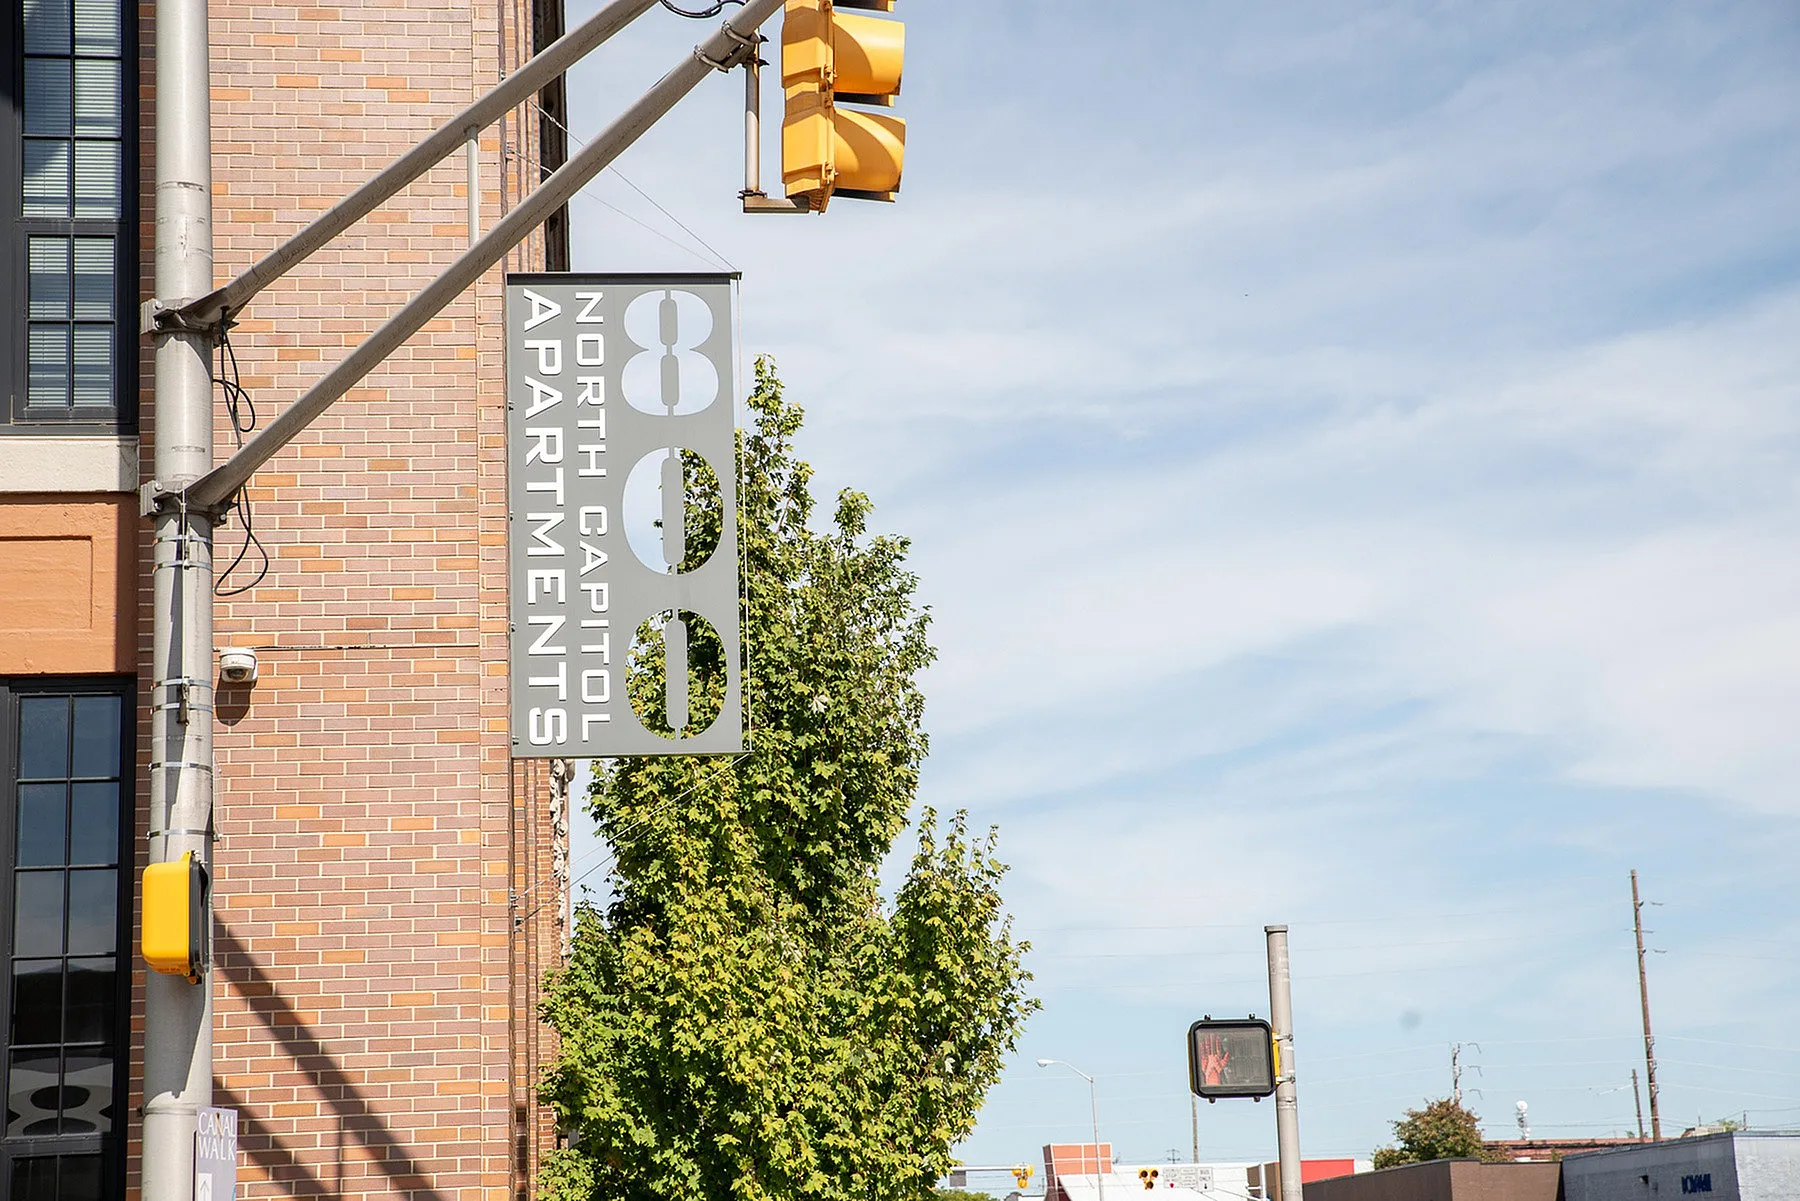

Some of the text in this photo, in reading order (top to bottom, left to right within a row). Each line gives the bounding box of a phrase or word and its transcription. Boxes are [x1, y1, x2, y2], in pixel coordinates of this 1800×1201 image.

[523, 288, 568, 746] APARTMENTS
[575, 291, 611, 742] NORTH CAPITOL
[620, 289, 728, 740] 800
[198, 1111, 236, 1137] CANAL
[198, 1137, 236, 1161] WALK
